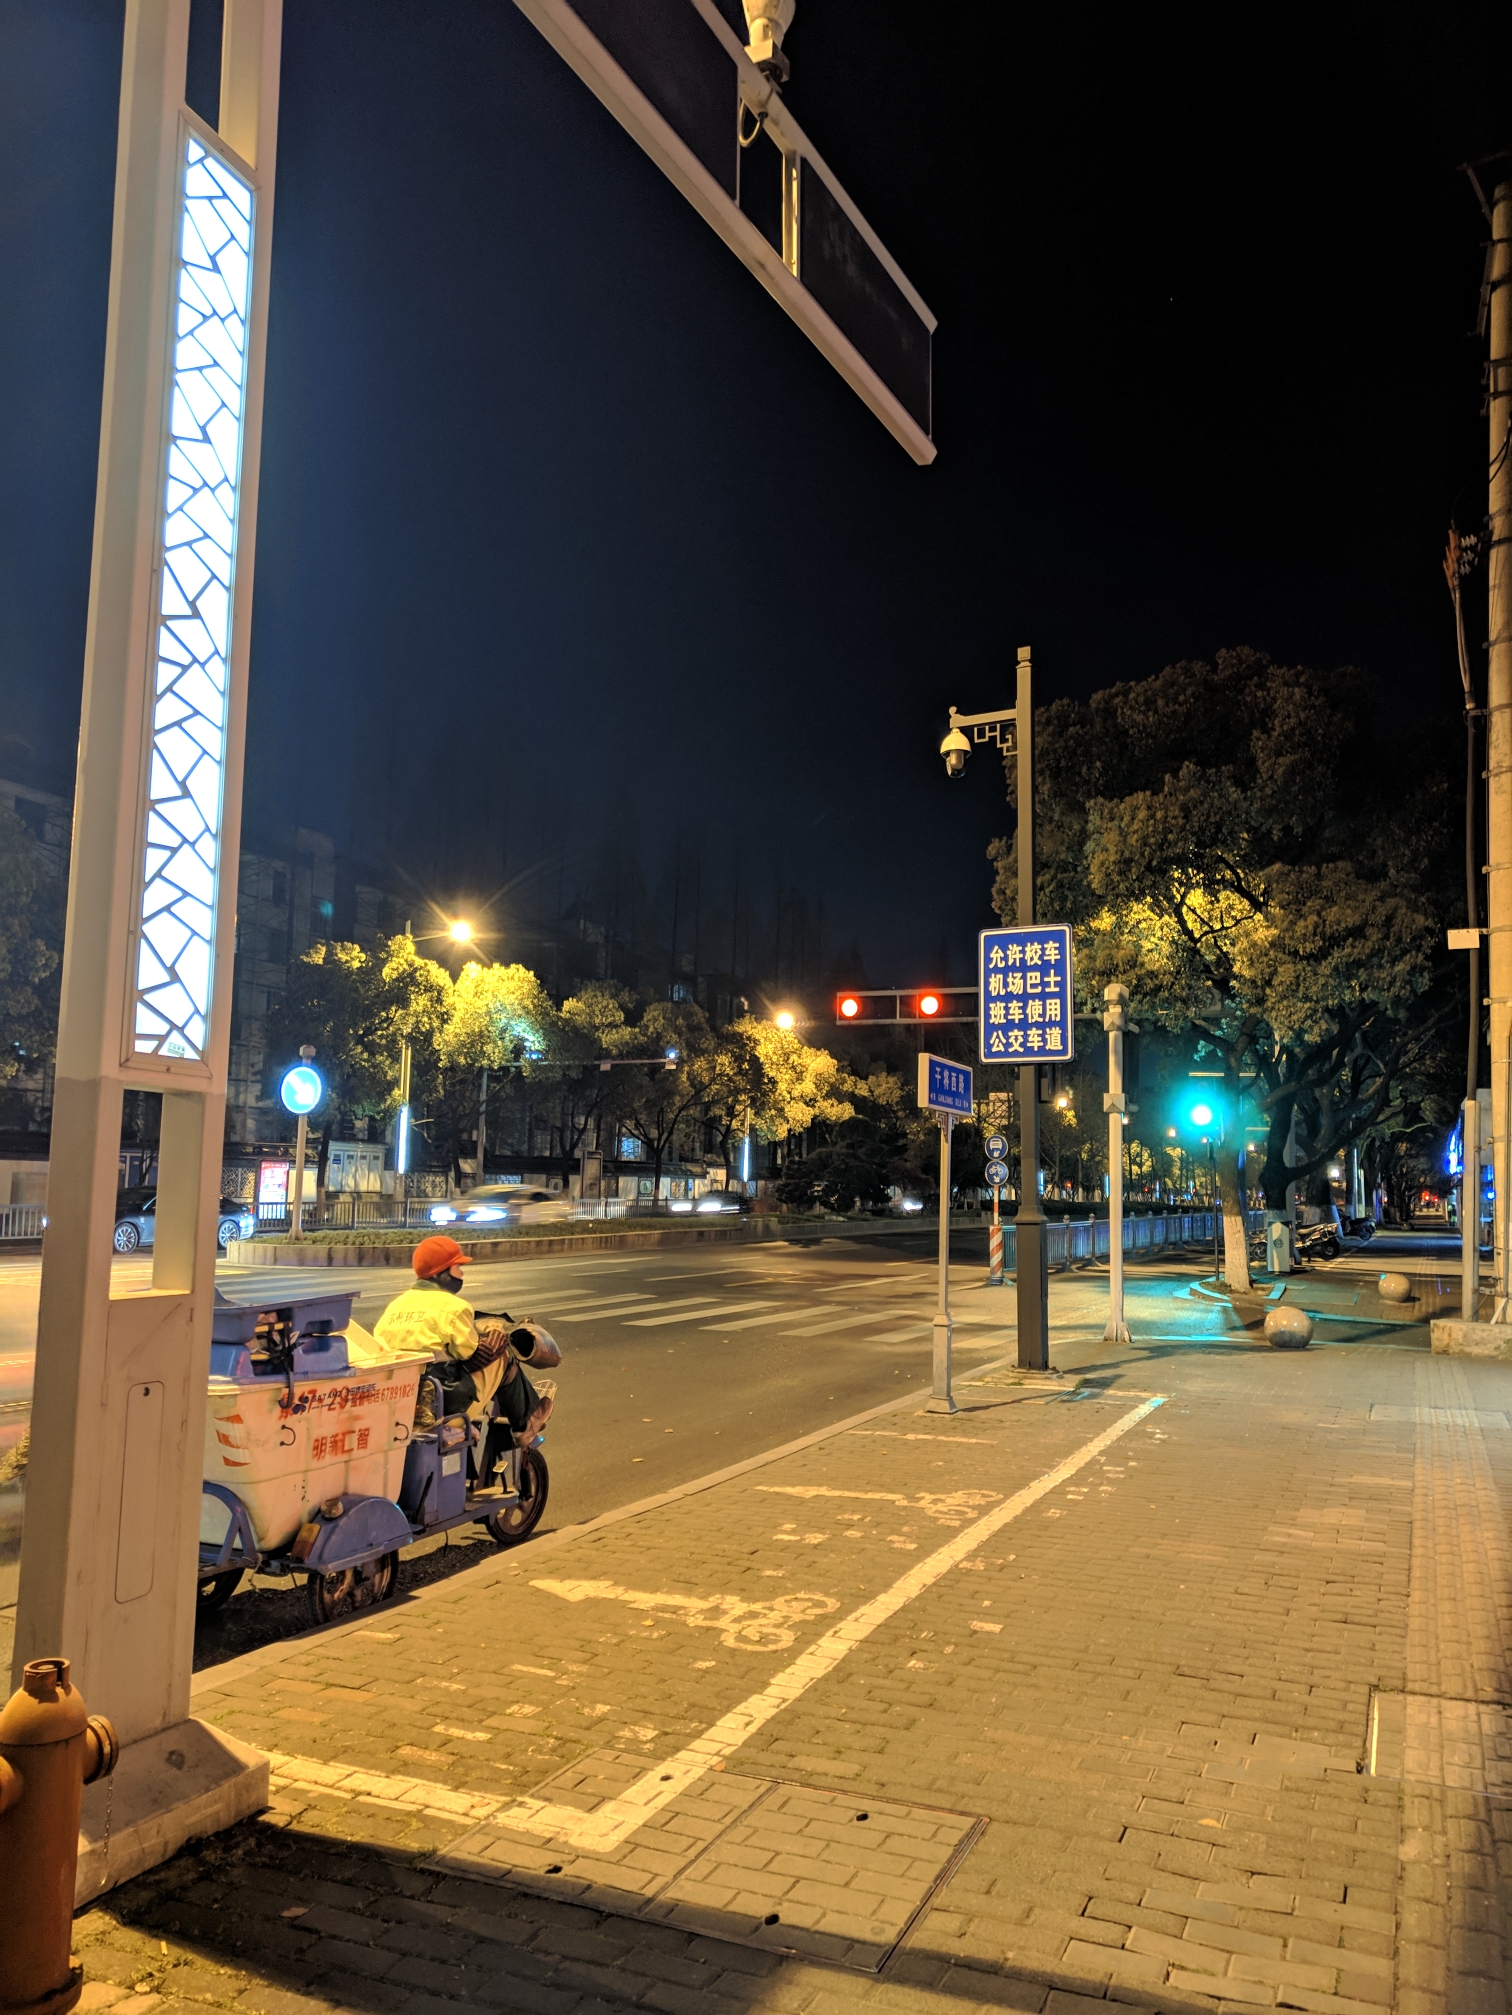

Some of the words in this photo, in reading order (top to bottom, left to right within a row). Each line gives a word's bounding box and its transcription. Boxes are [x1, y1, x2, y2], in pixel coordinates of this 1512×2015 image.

[989, 941, 1061, 969] 允许校车
[989, 969, 1061, 996] 机场巴士
[989, 999, 1061, 1025] 班车使用
[990, 1027, 1063, 1053] 公交车道
[935, 1067, 965, 1095] 干将西路
